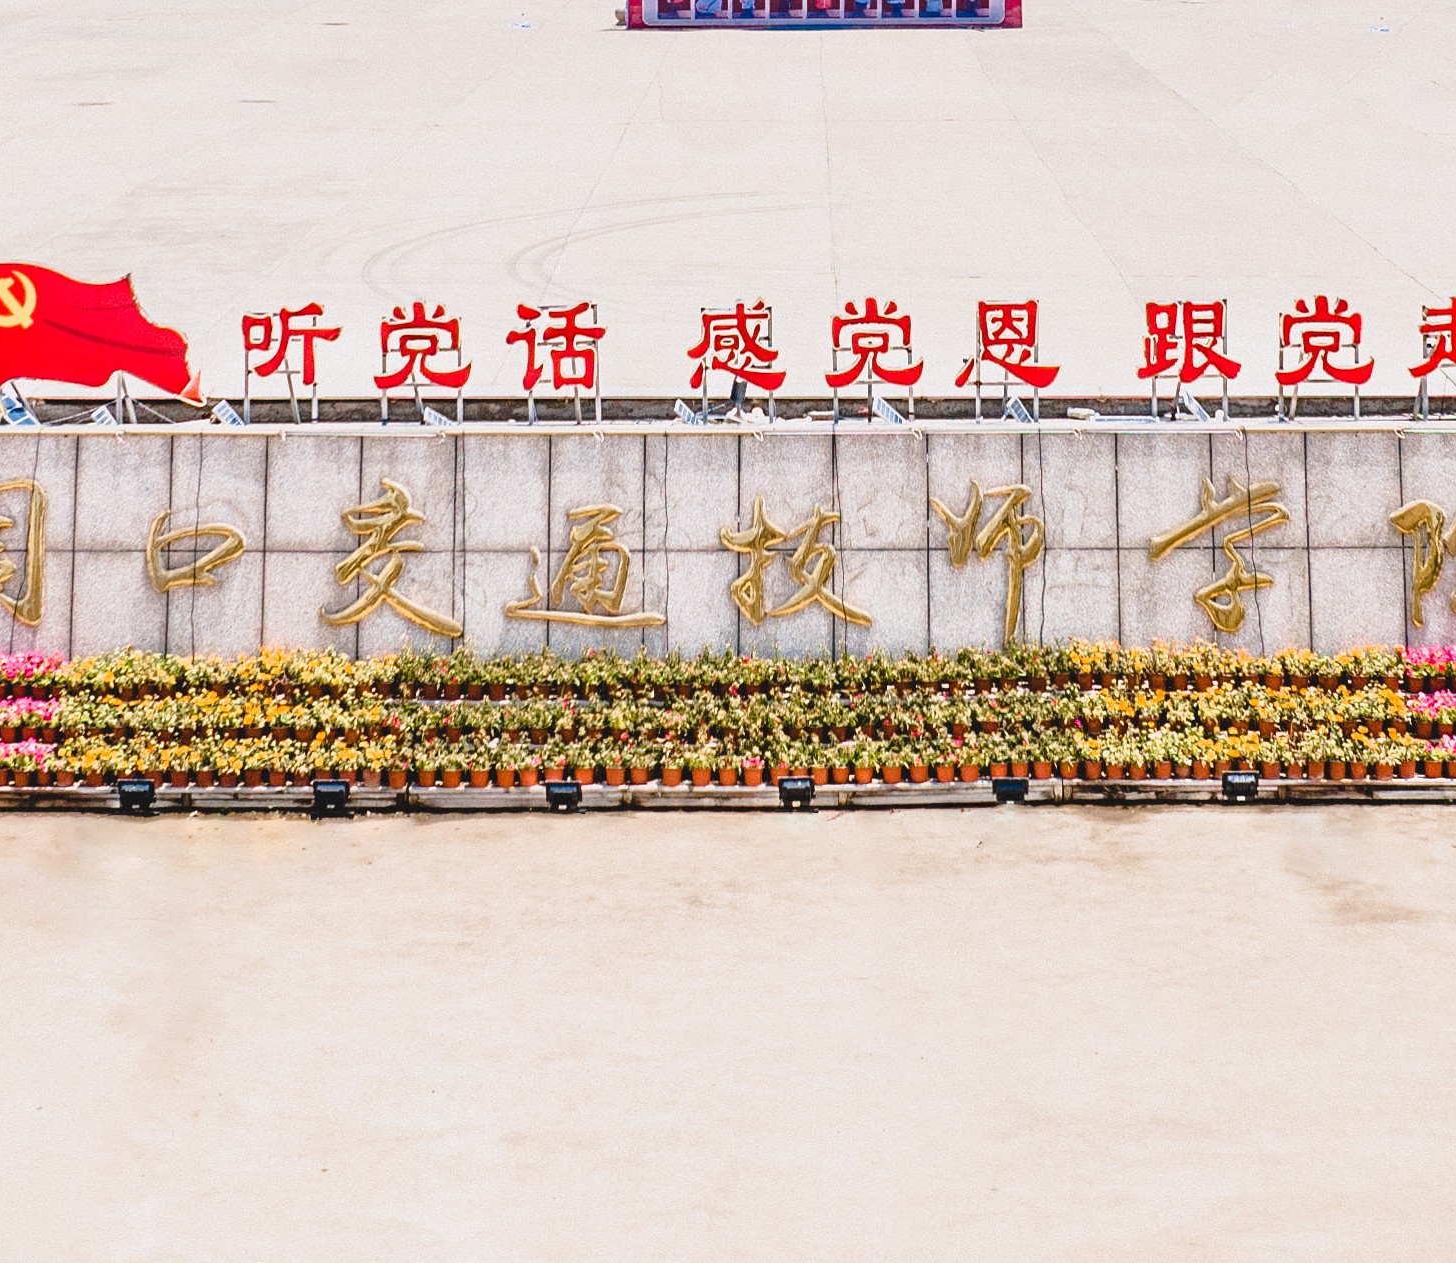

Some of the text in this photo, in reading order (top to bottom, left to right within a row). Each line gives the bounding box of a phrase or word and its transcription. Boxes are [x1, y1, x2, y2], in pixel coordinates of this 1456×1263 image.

[242, 300, 608, 391] 听党话
[687, 296, 1062, 391] 感党恩
